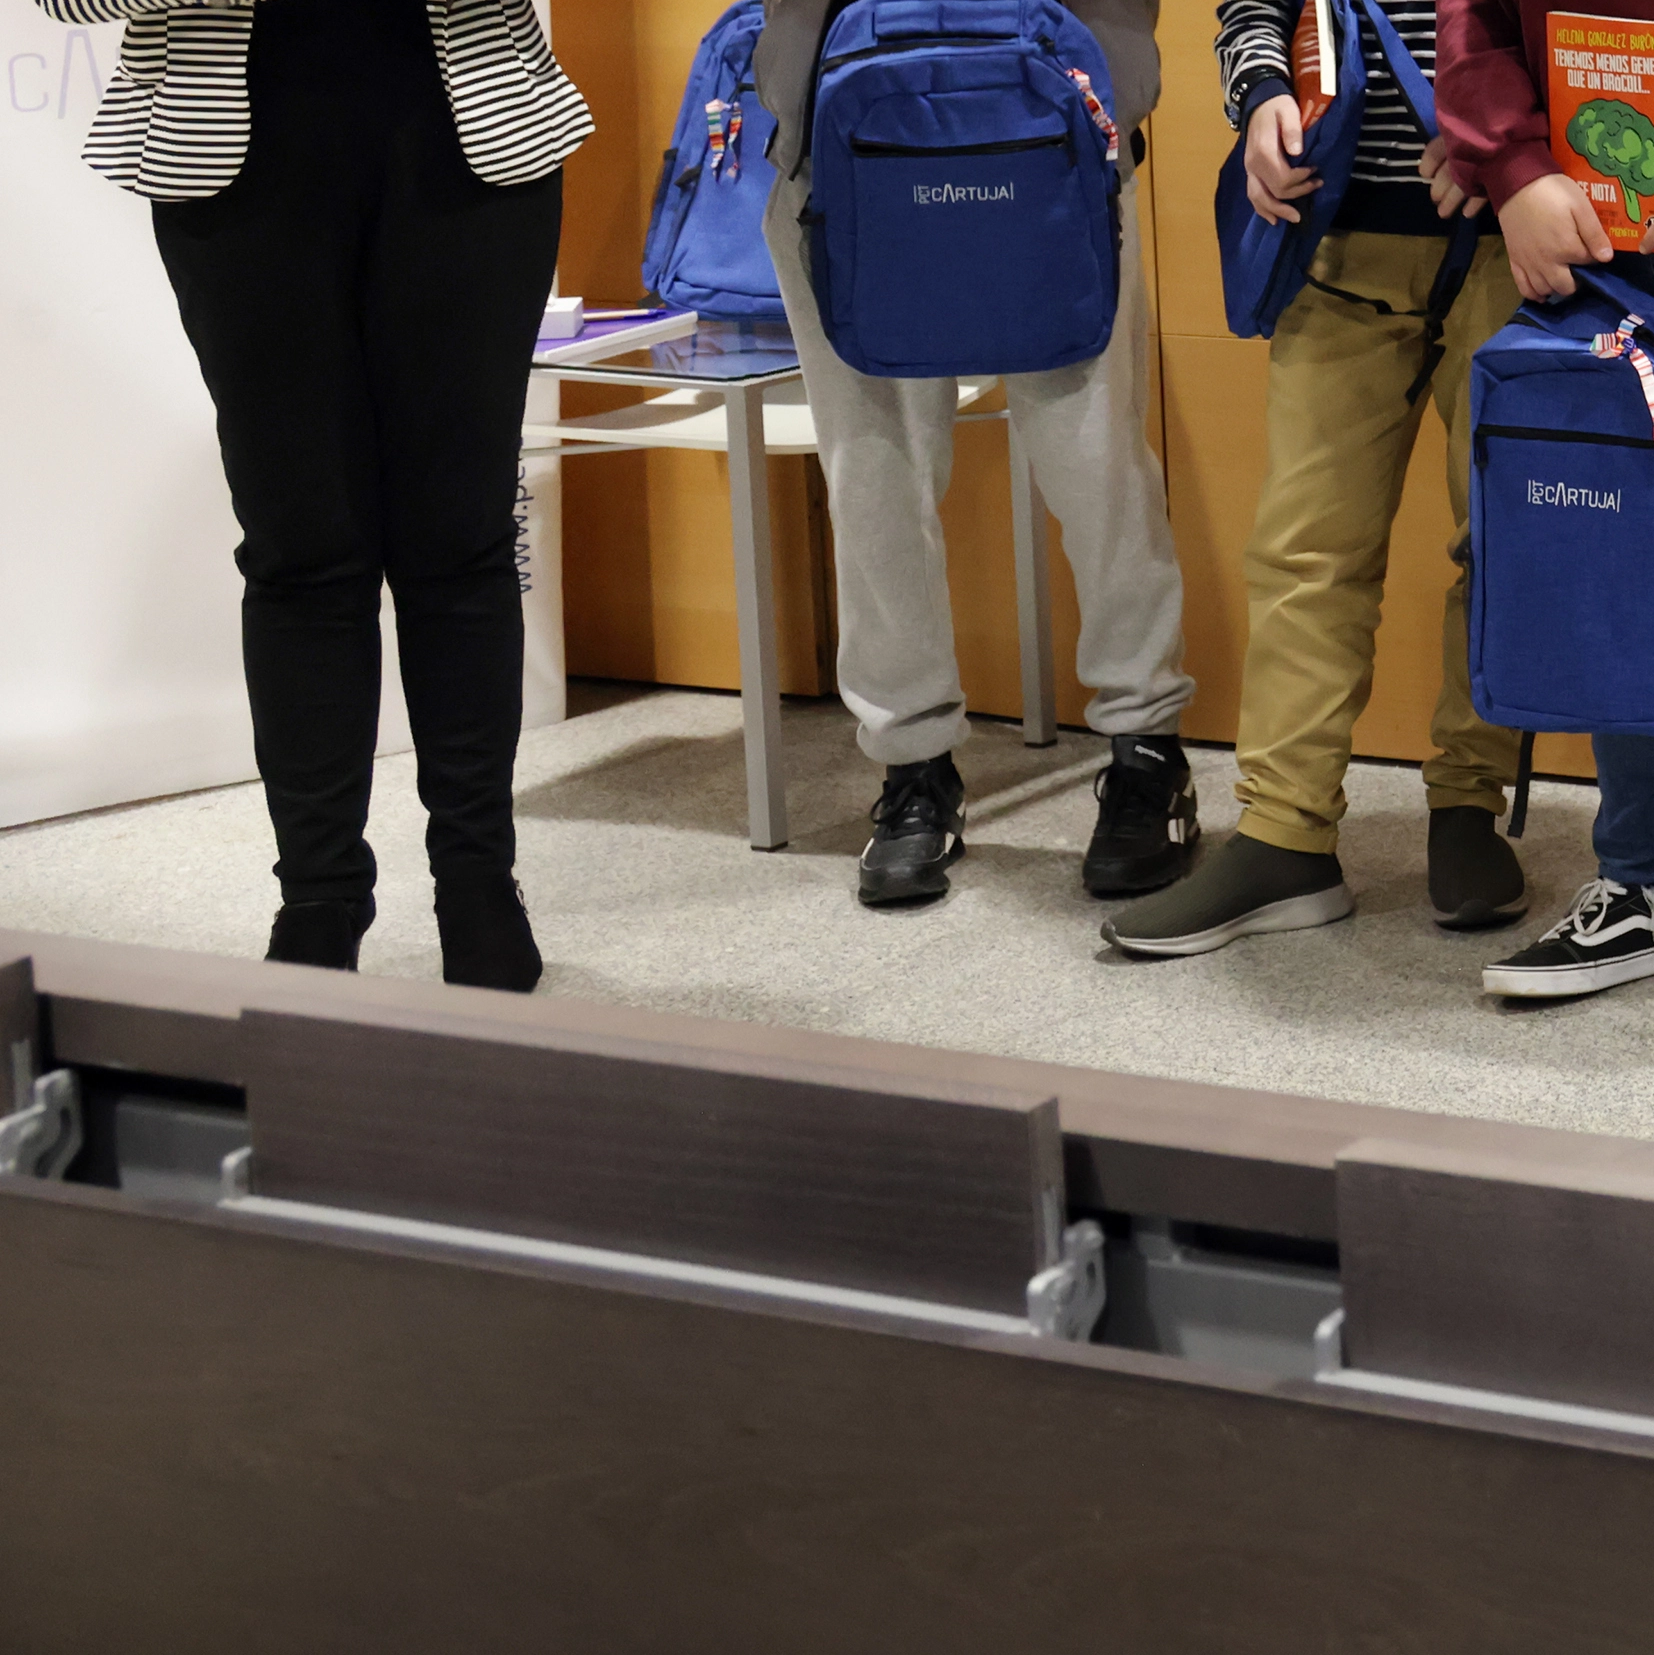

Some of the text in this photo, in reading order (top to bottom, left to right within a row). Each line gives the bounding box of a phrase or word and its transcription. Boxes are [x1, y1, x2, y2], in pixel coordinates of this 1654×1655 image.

[1554, 49, 1594, 70] TENEMOS
[1596, 54, 1628, 73] MENOS
[1568, 70, 1585, 88] QUE
[1587, 71, 1601, 90] UN
[1590, 183, 1617, 203] NOTA
[1531, 479, 1616, 510] PCT CARTUJA
